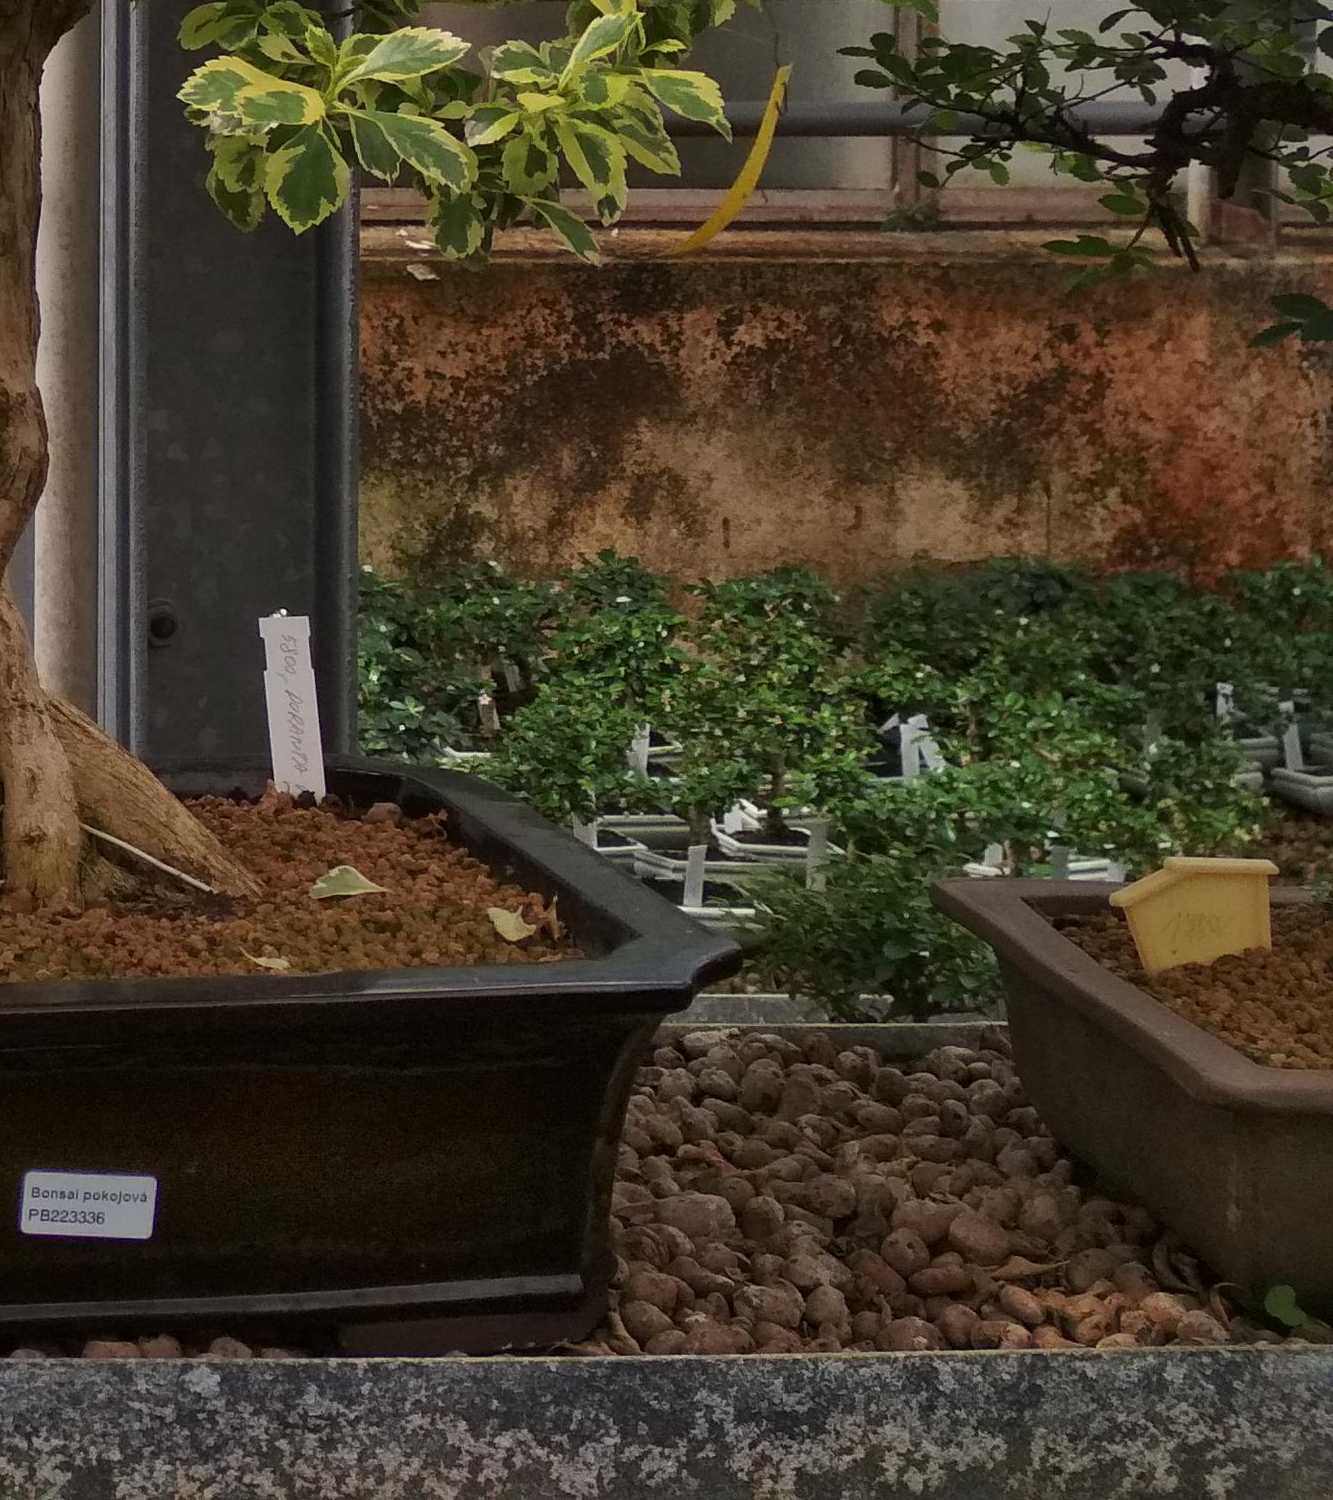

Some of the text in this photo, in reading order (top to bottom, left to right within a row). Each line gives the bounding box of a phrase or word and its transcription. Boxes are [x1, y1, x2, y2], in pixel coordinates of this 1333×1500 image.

[31, 1187, 148, 1205] Bonsai pokojová
[28, 1208, 105, 1225] PB223336
